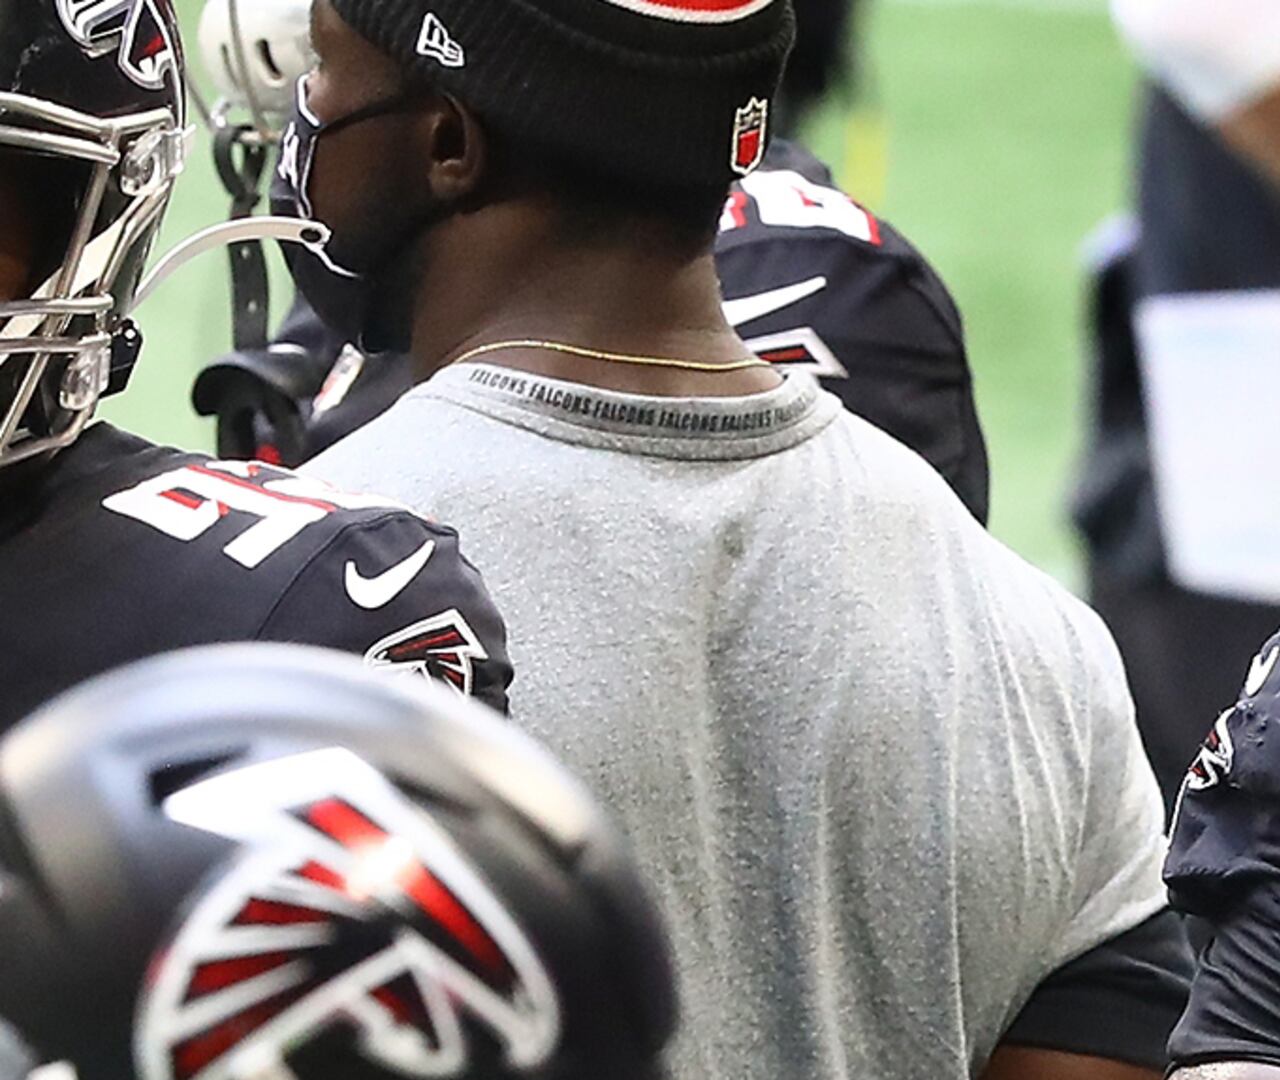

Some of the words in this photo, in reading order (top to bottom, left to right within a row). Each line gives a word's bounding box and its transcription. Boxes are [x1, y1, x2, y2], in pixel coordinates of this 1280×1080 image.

[469, 369, 526, 394] FALCONS
[529, 382, 592, 415] FALCONS
[593, 400, 655, 426] FALCONS
[658, 410, 718, 432] FALCONS
[718, 408, 771, 432] FALCONS
